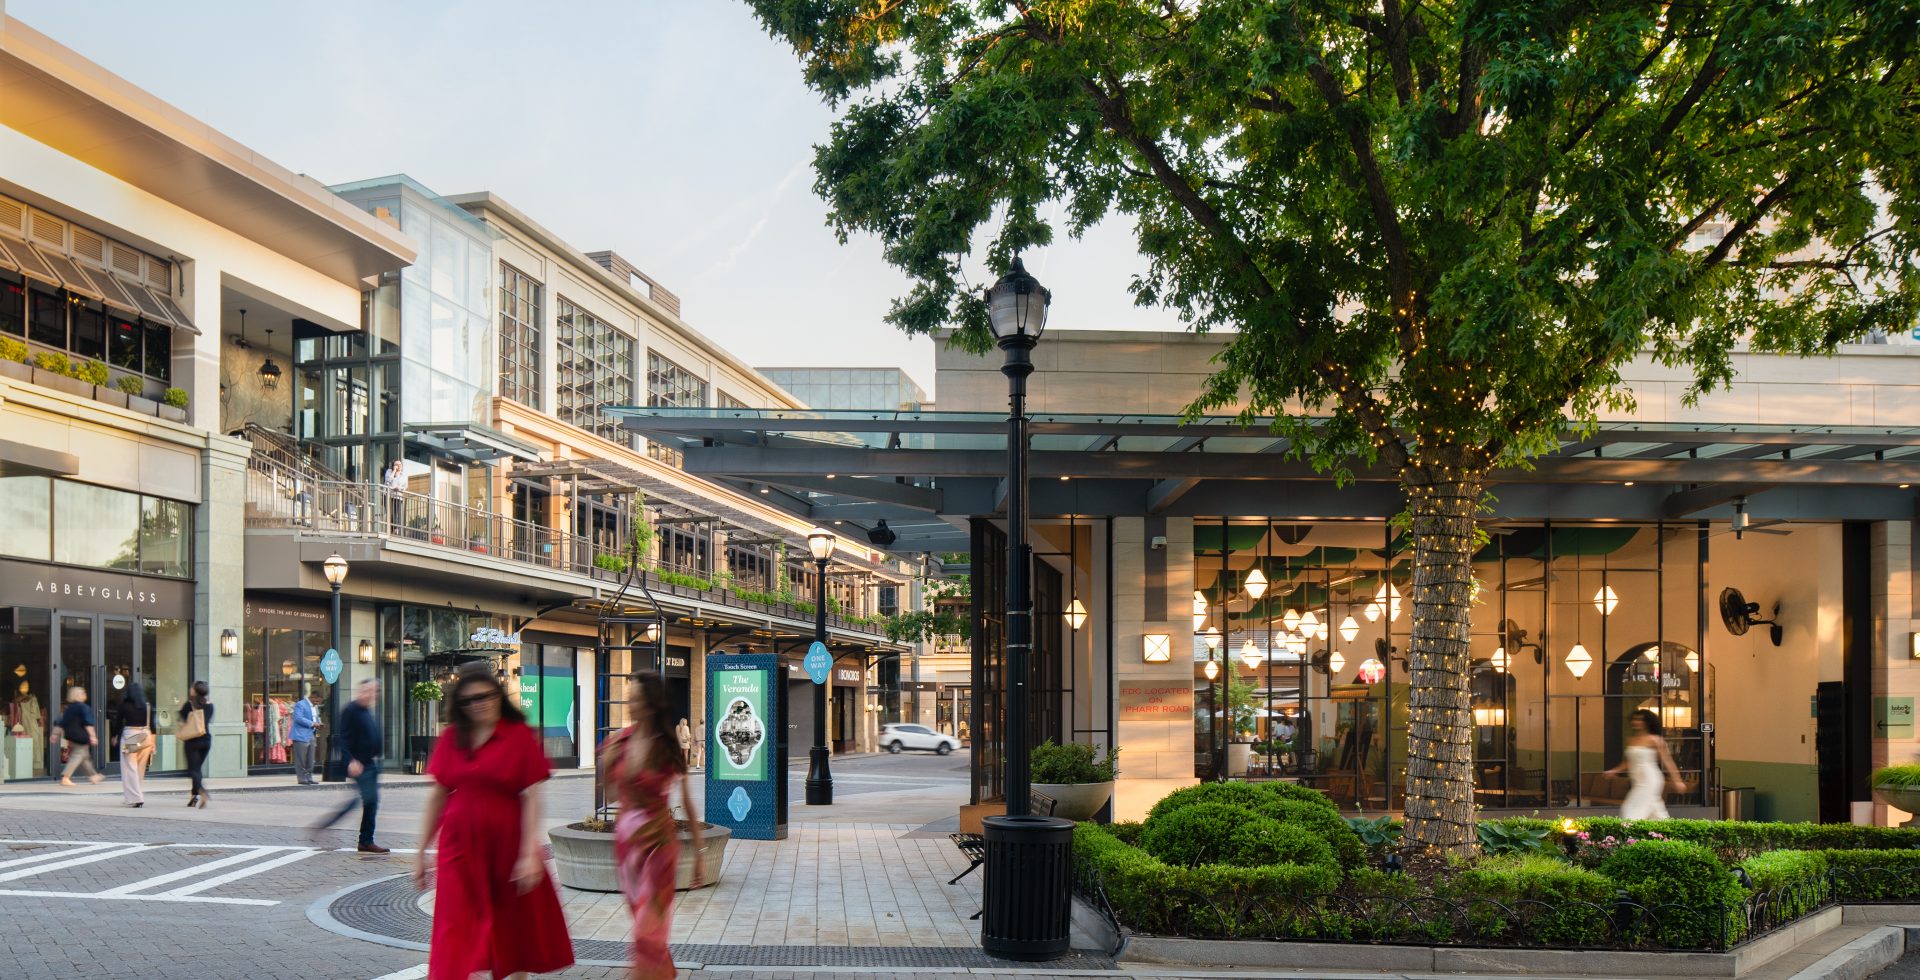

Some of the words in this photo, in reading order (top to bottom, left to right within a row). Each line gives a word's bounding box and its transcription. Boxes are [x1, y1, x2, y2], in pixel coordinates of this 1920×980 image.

[35, 581, 156, 603] ABBEYGLASS
[142, 618, 161, 627] 3033
[810, 654, 825, 662] ONE
[732, 674, 749, 684] The
[723, 684, 759, 693] Veranda
[1125, 705, 1159, 713] PHARR
[1162, 705, 1190, 713] ROAD
